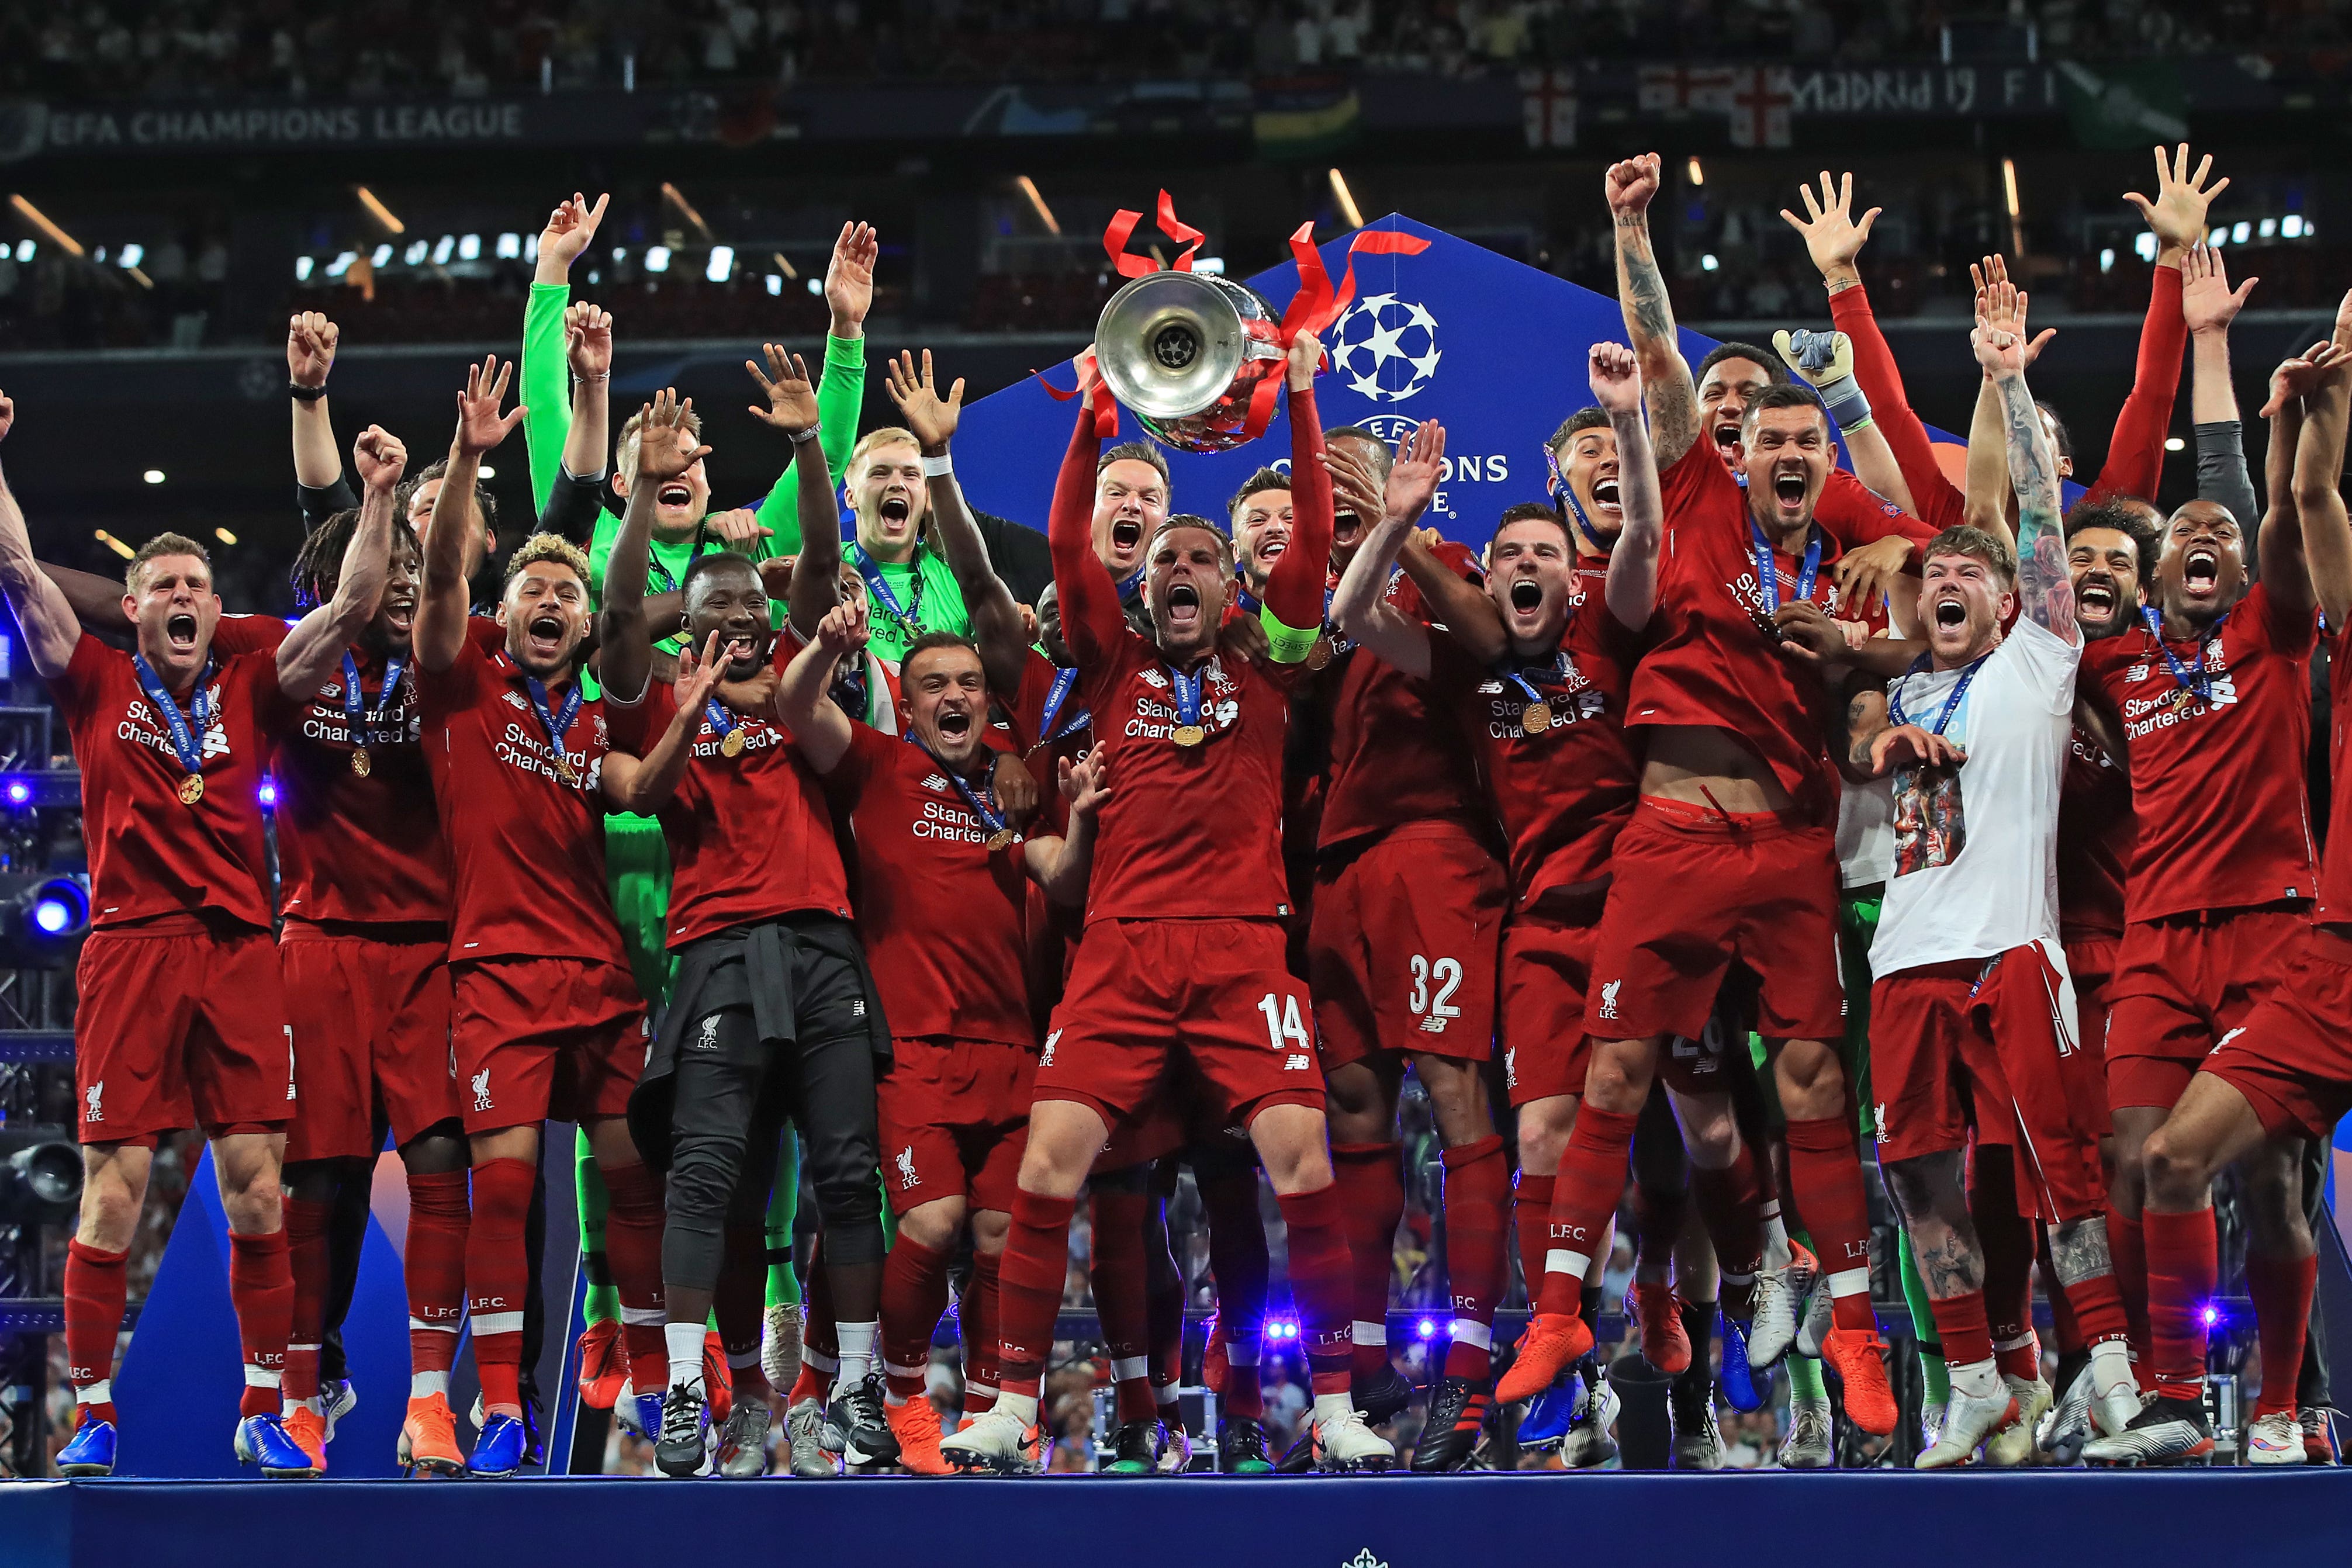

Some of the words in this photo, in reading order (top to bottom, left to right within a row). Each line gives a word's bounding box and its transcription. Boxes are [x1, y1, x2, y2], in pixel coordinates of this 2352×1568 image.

[50, 112, 119, 144] EFA
[130, 106, 361, 144] CHAMPIONS
[373, 103, 521, 140] LEAGUE
[1761, 555, 1772, 583] FINAL
[1409, 954, 1462, 1017] 32
[1257, 992, 1309, 1049] 14
